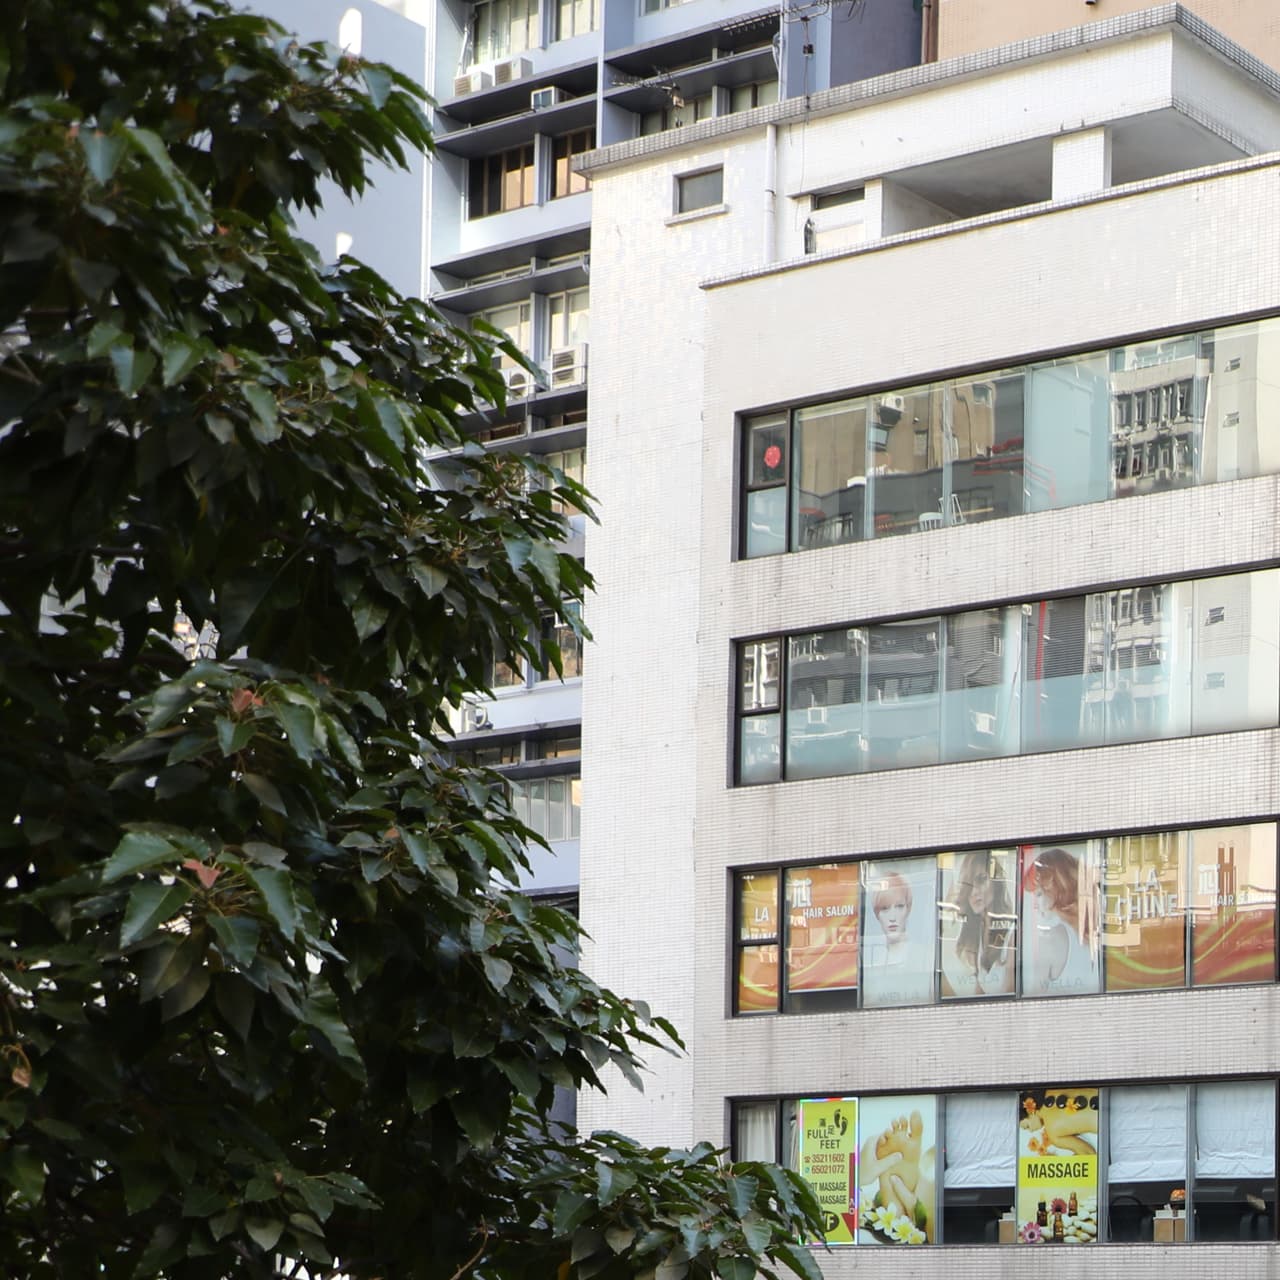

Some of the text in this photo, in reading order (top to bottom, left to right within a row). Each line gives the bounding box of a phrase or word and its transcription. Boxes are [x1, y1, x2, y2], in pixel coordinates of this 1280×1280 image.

[1135, 866, 1161, 892] LA
[754, 906, 769, 923] LA
[802, 904, 854, 920] HAIR SALON
[1039, 977, 1083, 990] WELLA
[807, 1128, 829, 1140] FULL
[820, 1139, 841, 1150] FEET
[811, 1153, 845, 1164] 35211602
[1026, 1160, 1089, 1181] MASSAGE
[819, 1181, 847, 1192] MASSAGE
[820, 1194, 847, 1205] MASSAGE
